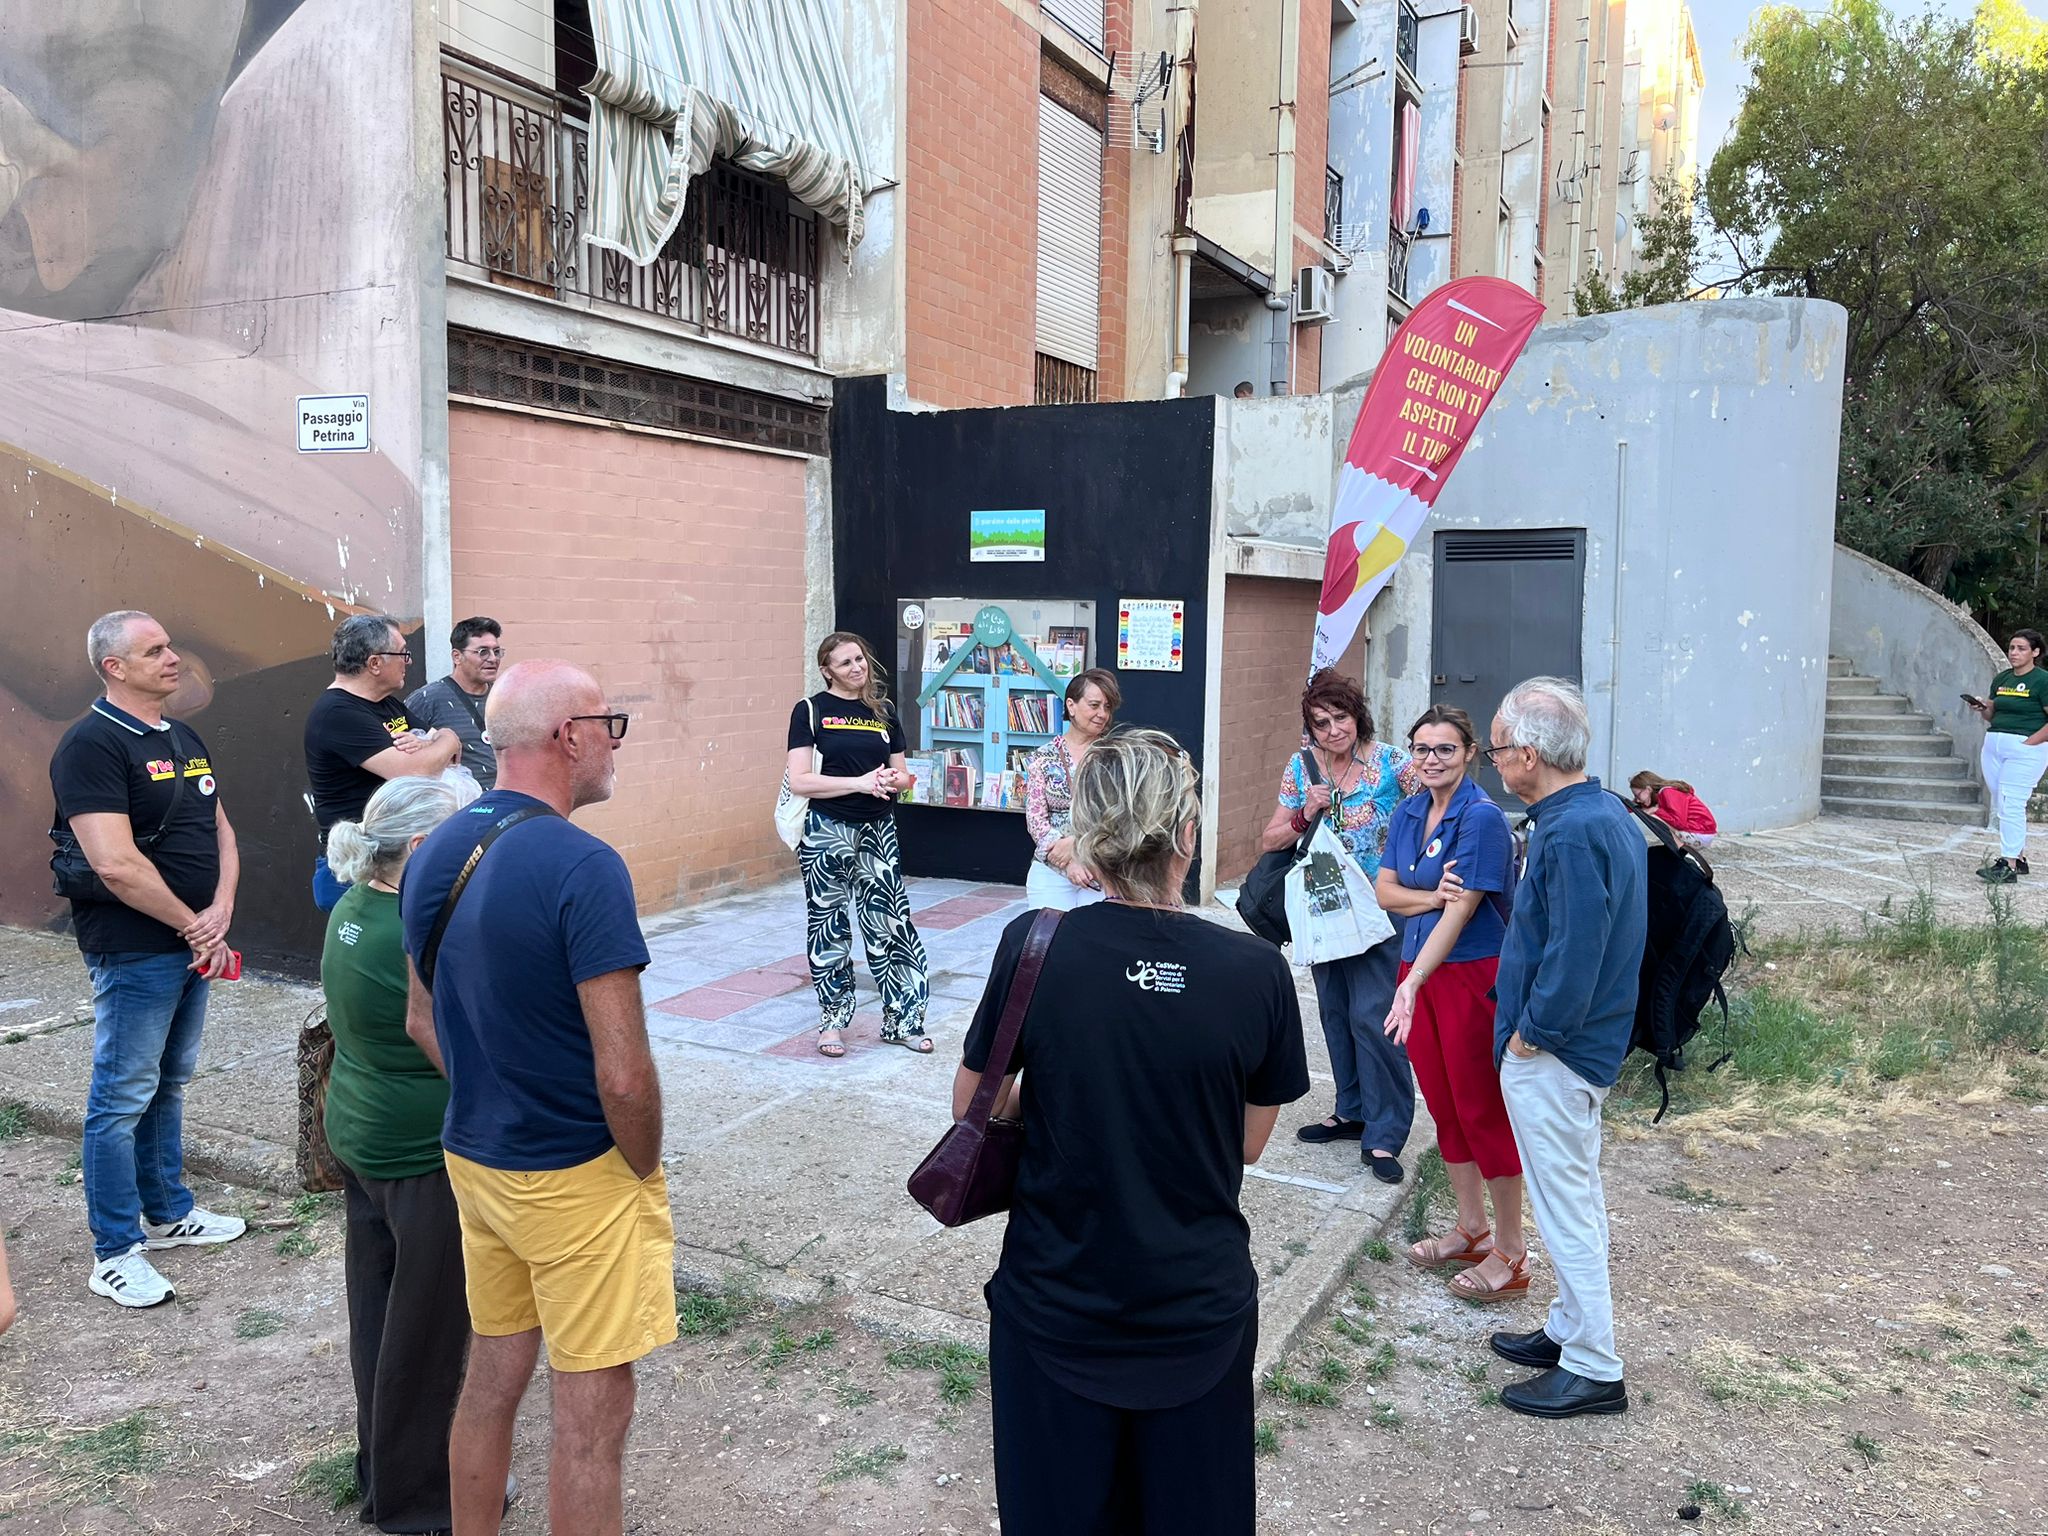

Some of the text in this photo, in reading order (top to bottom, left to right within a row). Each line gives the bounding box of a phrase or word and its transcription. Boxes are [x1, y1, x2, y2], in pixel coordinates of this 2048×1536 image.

[1454, 320, 1478, 347] UN
[1403, 332, 1502, 392] VOLONTARIATO
[353, 400, 365, 408] Via
[1406, 367, 1482, 417] CHE NON TI
[303, 410, 363, 426] Passaggio
[1398, 398, 1464, 443] ASPETTI...
[313, 429, 355, 442] Petrina
[1402, 430, 1417, 455] IL
